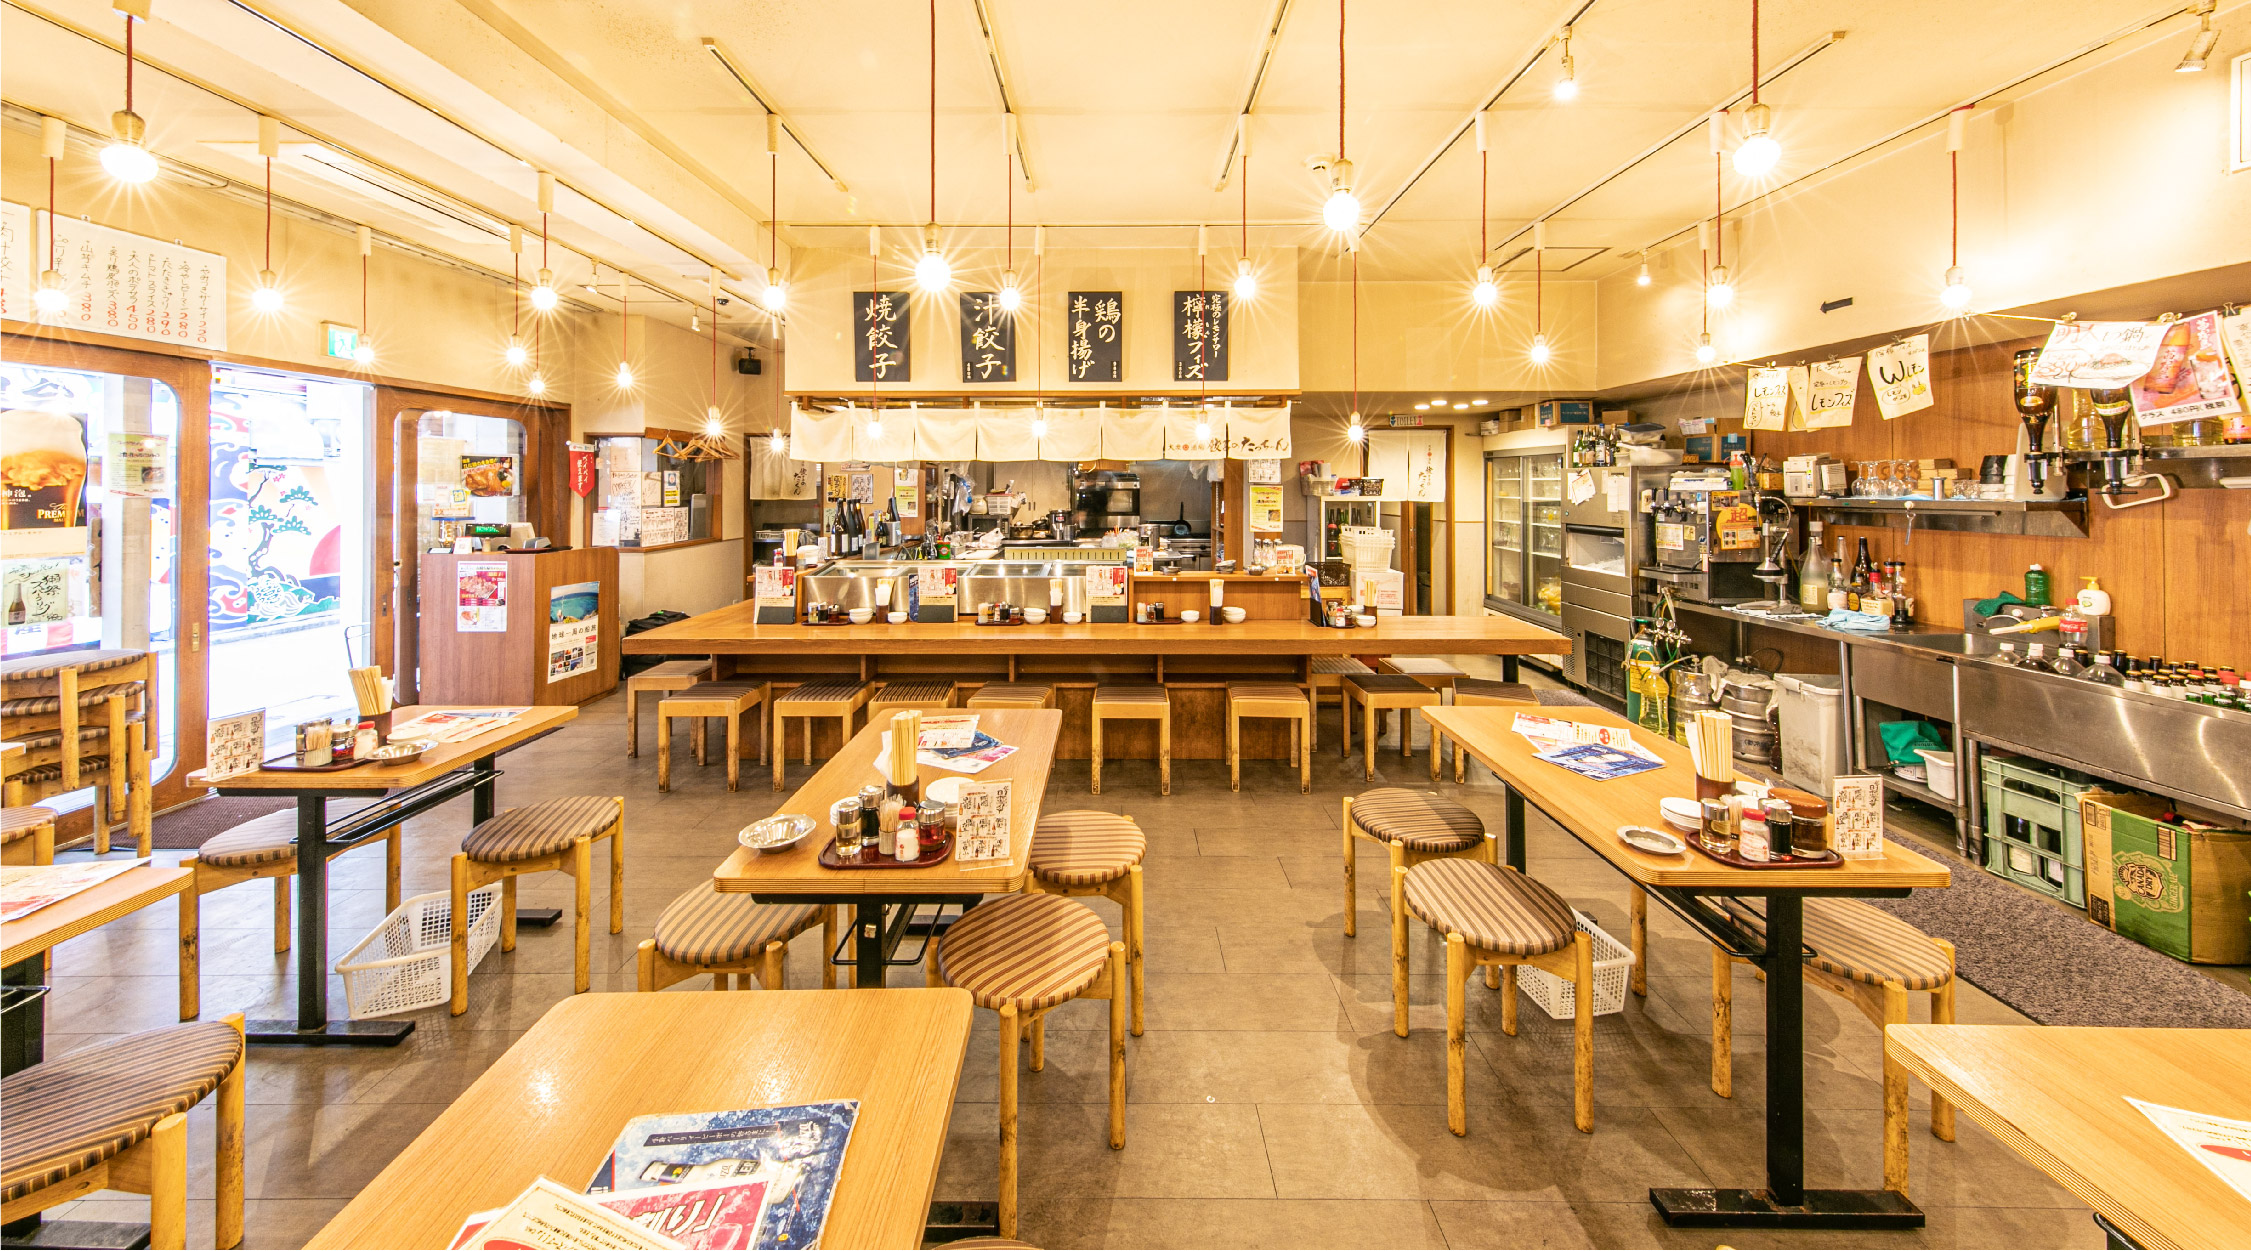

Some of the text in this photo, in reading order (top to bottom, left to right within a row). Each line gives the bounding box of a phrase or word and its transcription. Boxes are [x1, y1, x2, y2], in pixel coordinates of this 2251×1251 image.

[146, 308, 156, 334] 280
[177, 312, 189, 339] 280
[864, 294, 898, 379] 焼餃子
[972, 294, 1006, 379] 汁餃子
[1070, 295, 1095, 379] 半身揚げ
[1094, 297, 1121, 343] 鶏の
[1181, 294, 1208, 379] 檸檬フィズ
[1210, 293, 1222, 358] 究極のレモンサワー
[1726, 507, 1748, 524] 超
[551, 624, 597, 640] 地球一周の船旅
[2136, 865, 2147, 897] CANADA
[2145, 876, 2153, 891] DRY
